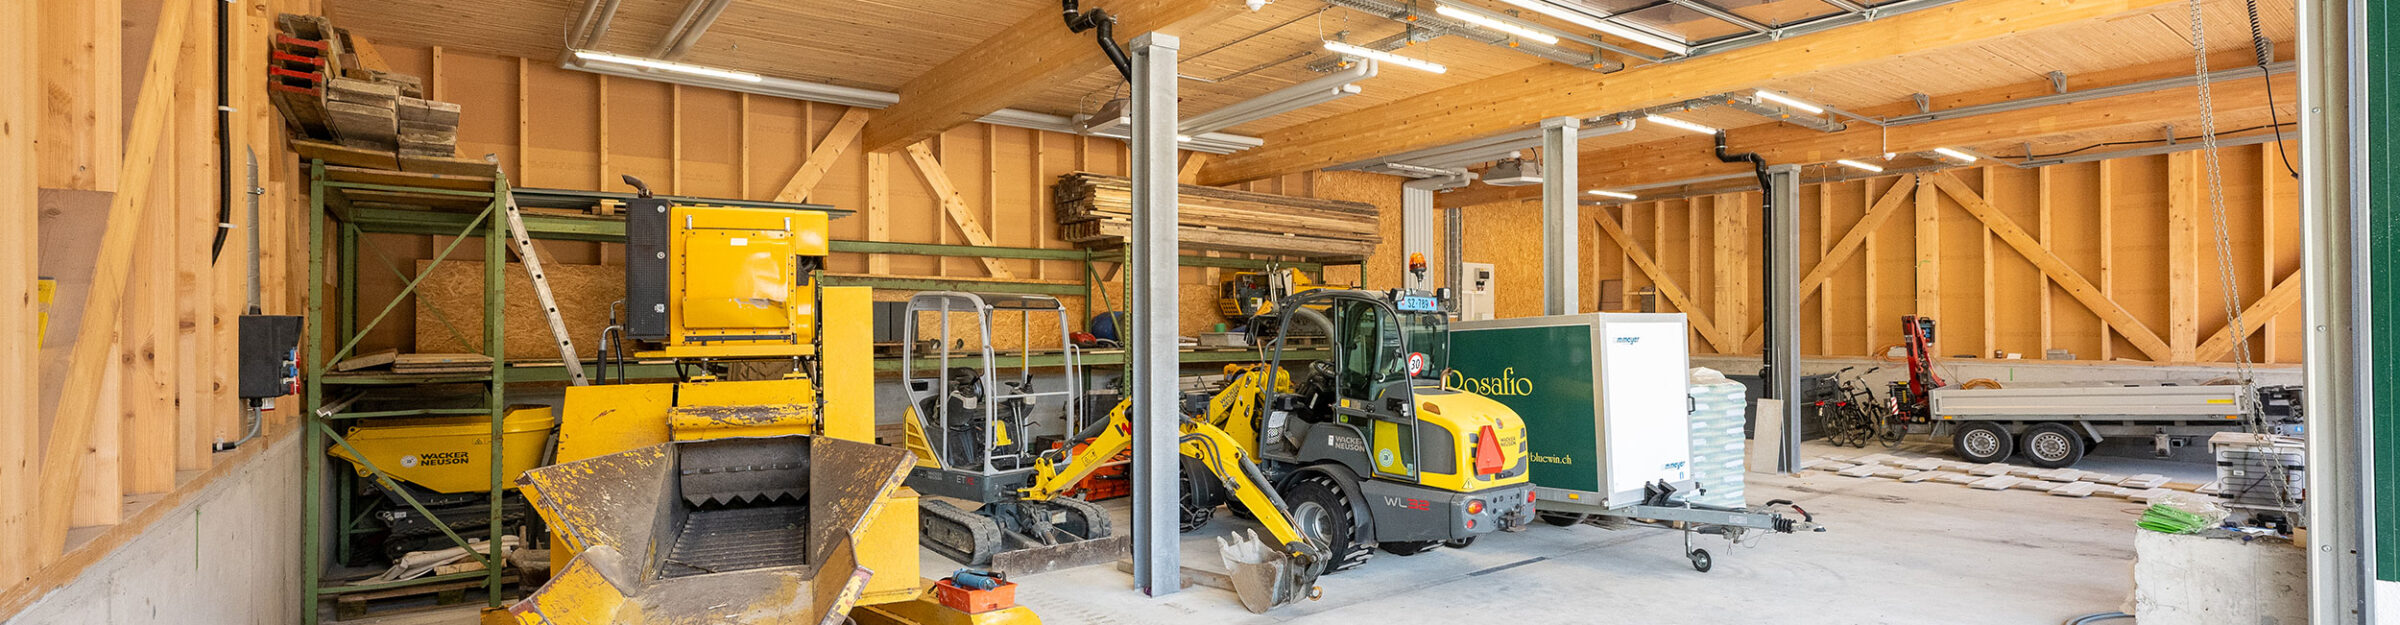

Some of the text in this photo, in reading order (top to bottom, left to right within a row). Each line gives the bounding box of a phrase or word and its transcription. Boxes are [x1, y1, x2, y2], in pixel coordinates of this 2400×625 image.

[1411, 358, 1421, 370] 30
[1334, 435, 1363, 444] WACKE
[420, 451, 469, 460] WACKER
[1528, 452, 1572, 465] bluewin.ch
[420, 458, 469, 466] NEUSON
[1384, 495, 1430, 511] WL32
